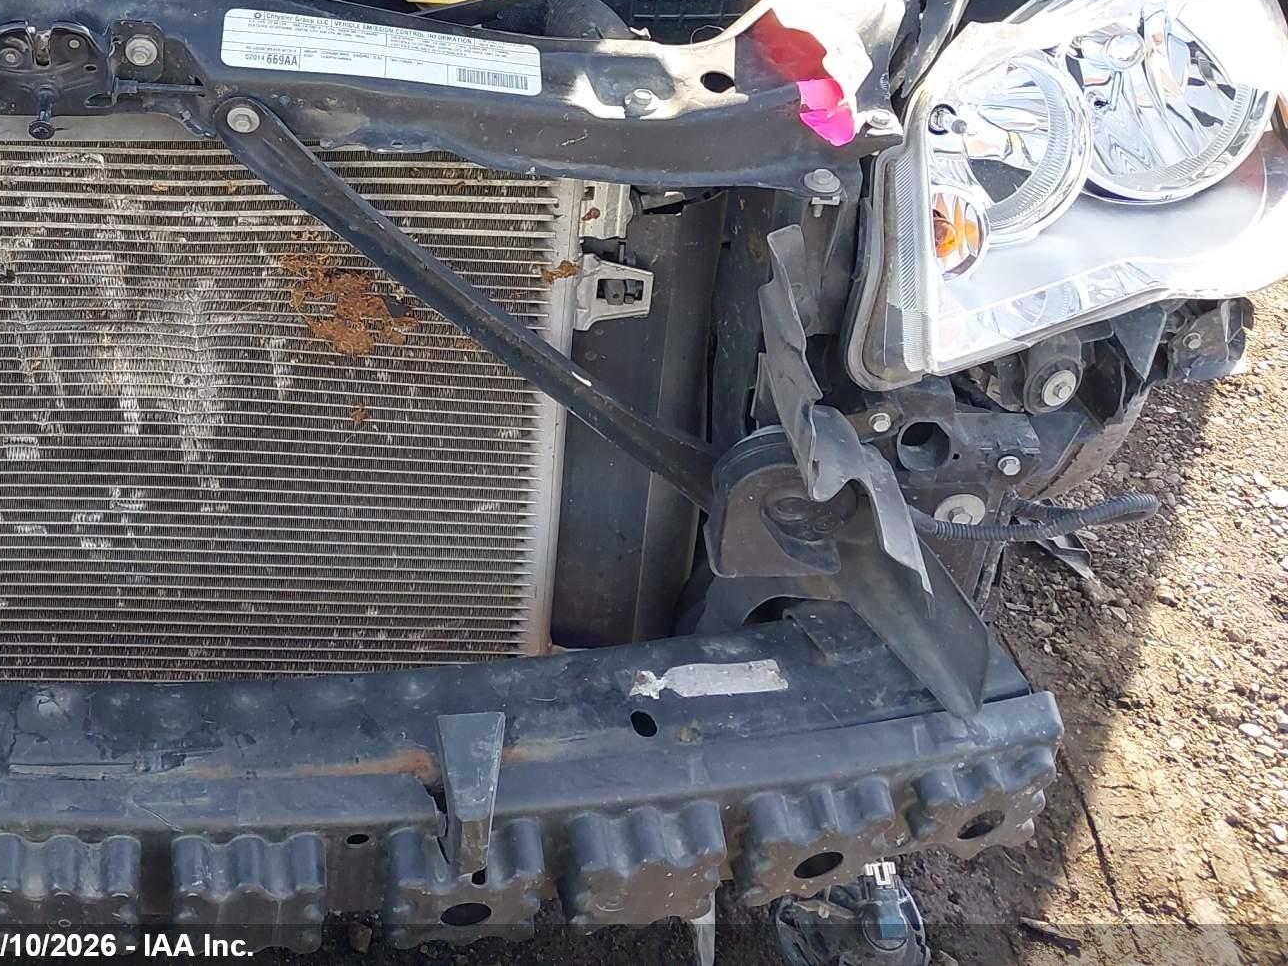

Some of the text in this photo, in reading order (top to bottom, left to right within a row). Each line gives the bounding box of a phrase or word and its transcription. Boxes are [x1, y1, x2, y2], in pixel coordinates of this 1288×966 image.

[266, 12, 293, 22] Chrysler
[295, 15, 315, 24] Group
[334, 21, 360, 29] VEHICLE
[362, 24, 394, 33] EMISSION
[395, 28, 424, 38] CONTROL
[427, 33, 472, 44] INFORMATION
[266, 53, 298, 66] 669AA
